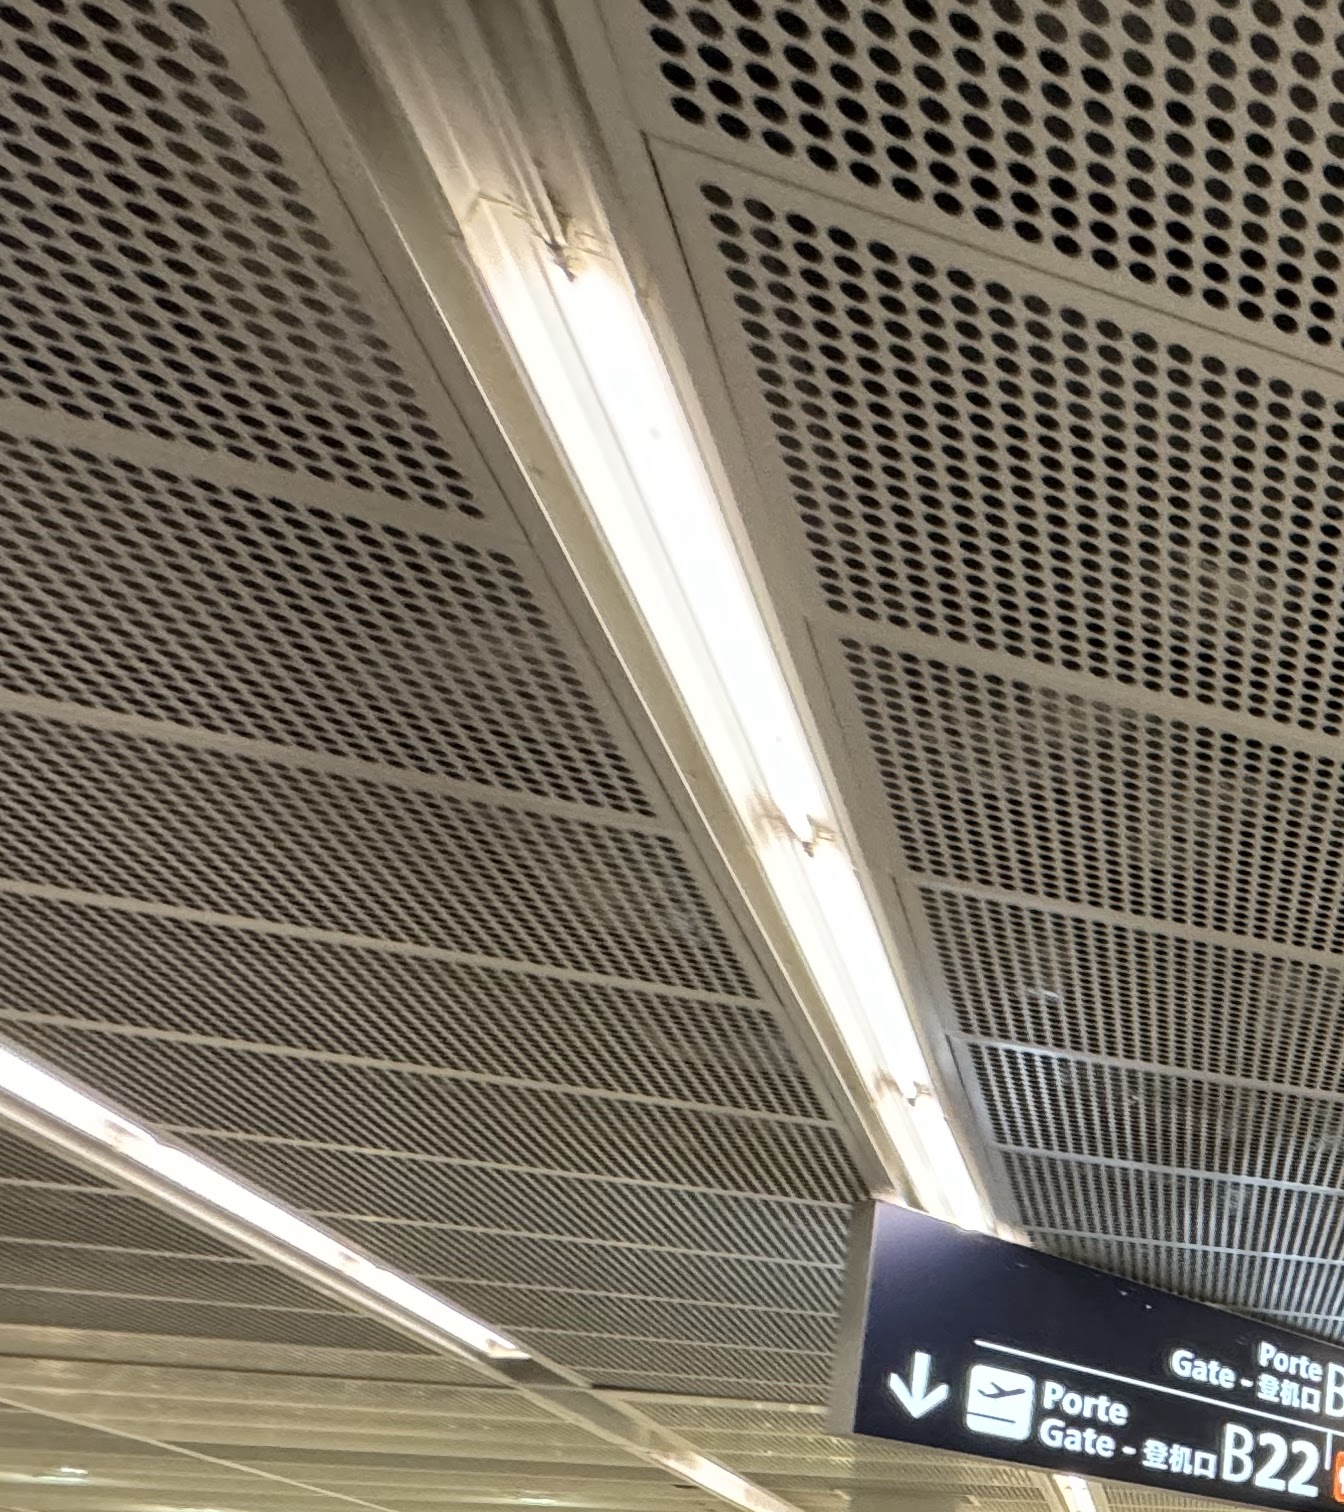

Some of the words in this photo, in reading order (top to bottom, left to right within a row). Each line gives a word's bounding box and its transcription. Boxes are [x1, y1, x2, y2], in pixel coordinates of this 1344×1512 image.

[1171, 1349, 1237, 1389] Gate
[1257, 1373, 1321, 1413] 登机口
[1258, 1340, 1323, 1382] Porte
[1043, 1380, 1129, 1426] Porte
[1039, 1418, 1116, 1458] Gate
[1142, 1438, 1217, 1480] 登机口
[1221, 1422, 1320, 1498] B22
